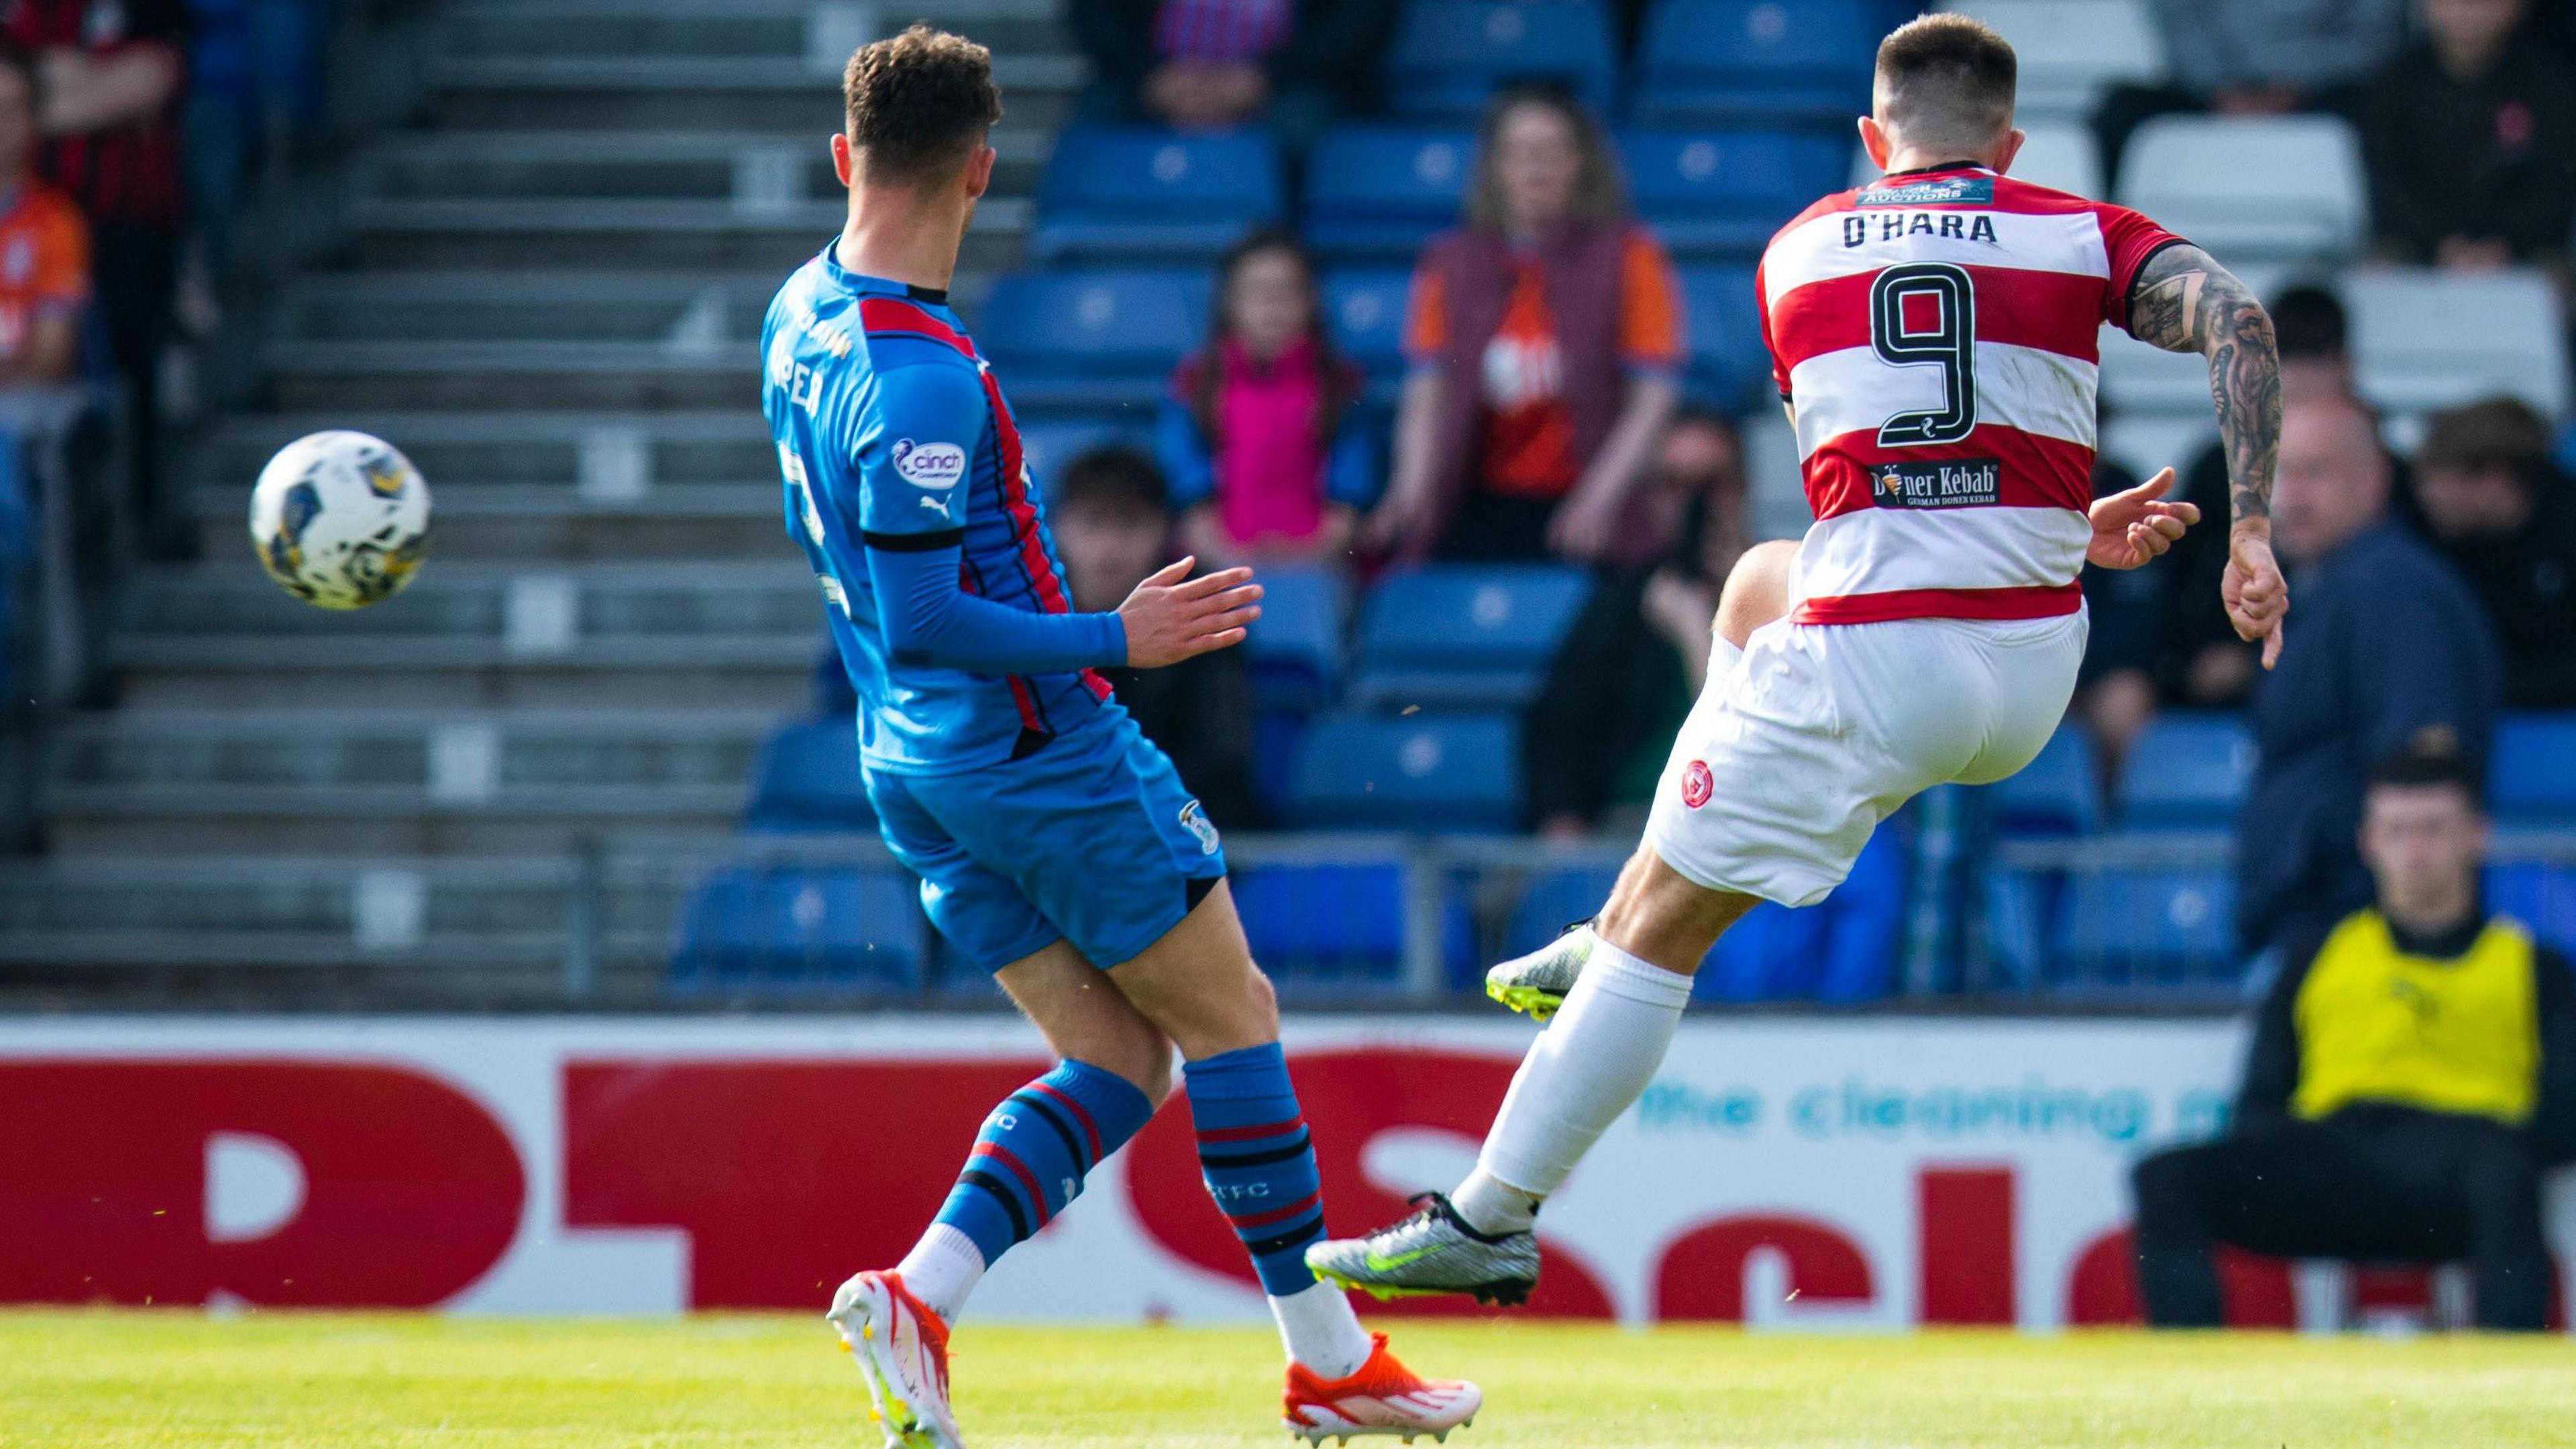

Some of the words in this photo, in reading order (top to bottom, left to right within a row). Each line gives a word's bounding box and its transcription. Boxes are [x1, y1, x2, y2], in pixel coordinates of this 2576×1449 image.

[1862, 189, 1962, 202] AUCTIONS
[1843, 213, 1997, 248] O'HARA
[1870, 261, 1978, 447] 9
[1939, 465, 1994, 495] Kebab
[1907, 496, 1939, 506] GERMAN
[1970, 494, 1996, 503] KEBAB
[1787, 1072, 2151, 1152] cleaning
